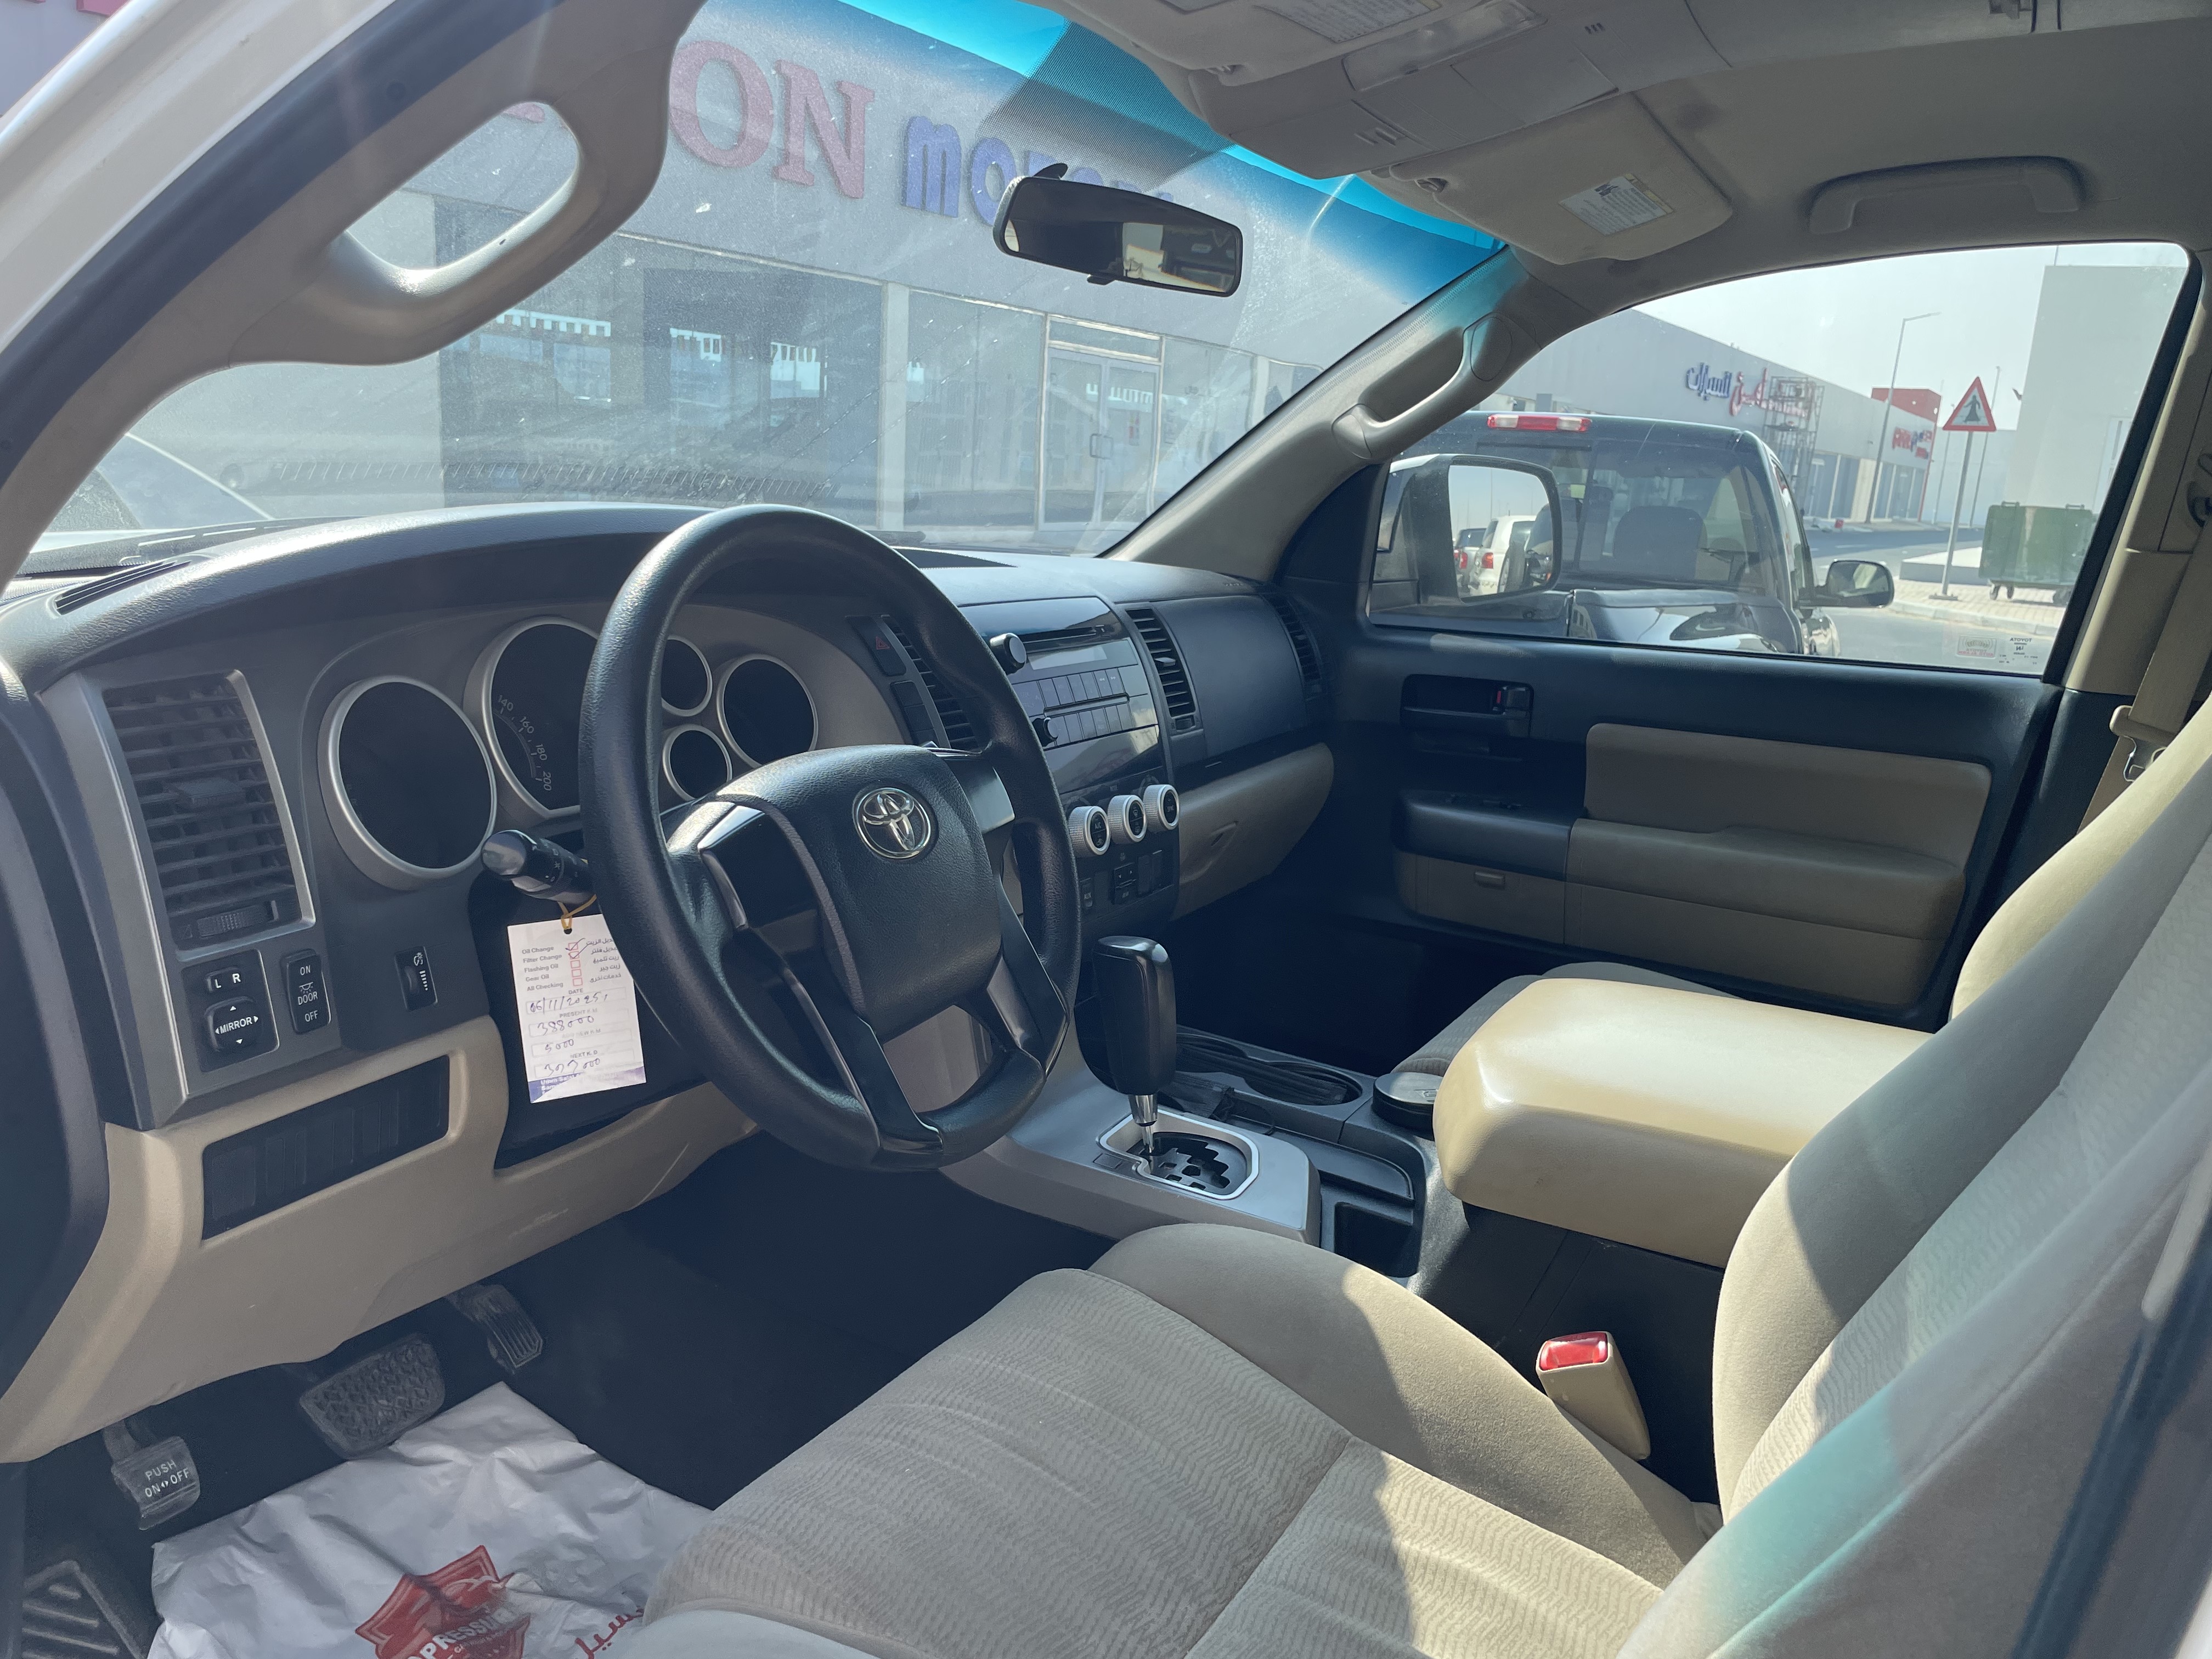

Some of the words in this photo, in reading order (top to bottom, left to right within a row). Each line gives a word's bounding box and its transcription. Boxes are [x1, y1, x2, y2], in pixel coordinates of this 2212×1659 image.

[498, 695, 514, 712] 140
[520, 716, 534, 734] 160
[535, 743, 548, 761] 180
[543, 771, 552, 791] 200
[300, 964, 312, 976] ON
[215, 979, 221, 989] L
[232, 973, 242, 984] R
[535, 982, 563, 990] Checking
[297, 991, 318, 1006] DOOR
[304, 1010, 318, 1023] OFF
[559, 1010, 585, 1018] PRESENT
[219, 1017, 253, 1035] MIRROR
[145, 1459, 177, 1481] PUSH
[144, 1483, 161, 1498] ON
[170, 1468, 190, 1485] OFF
